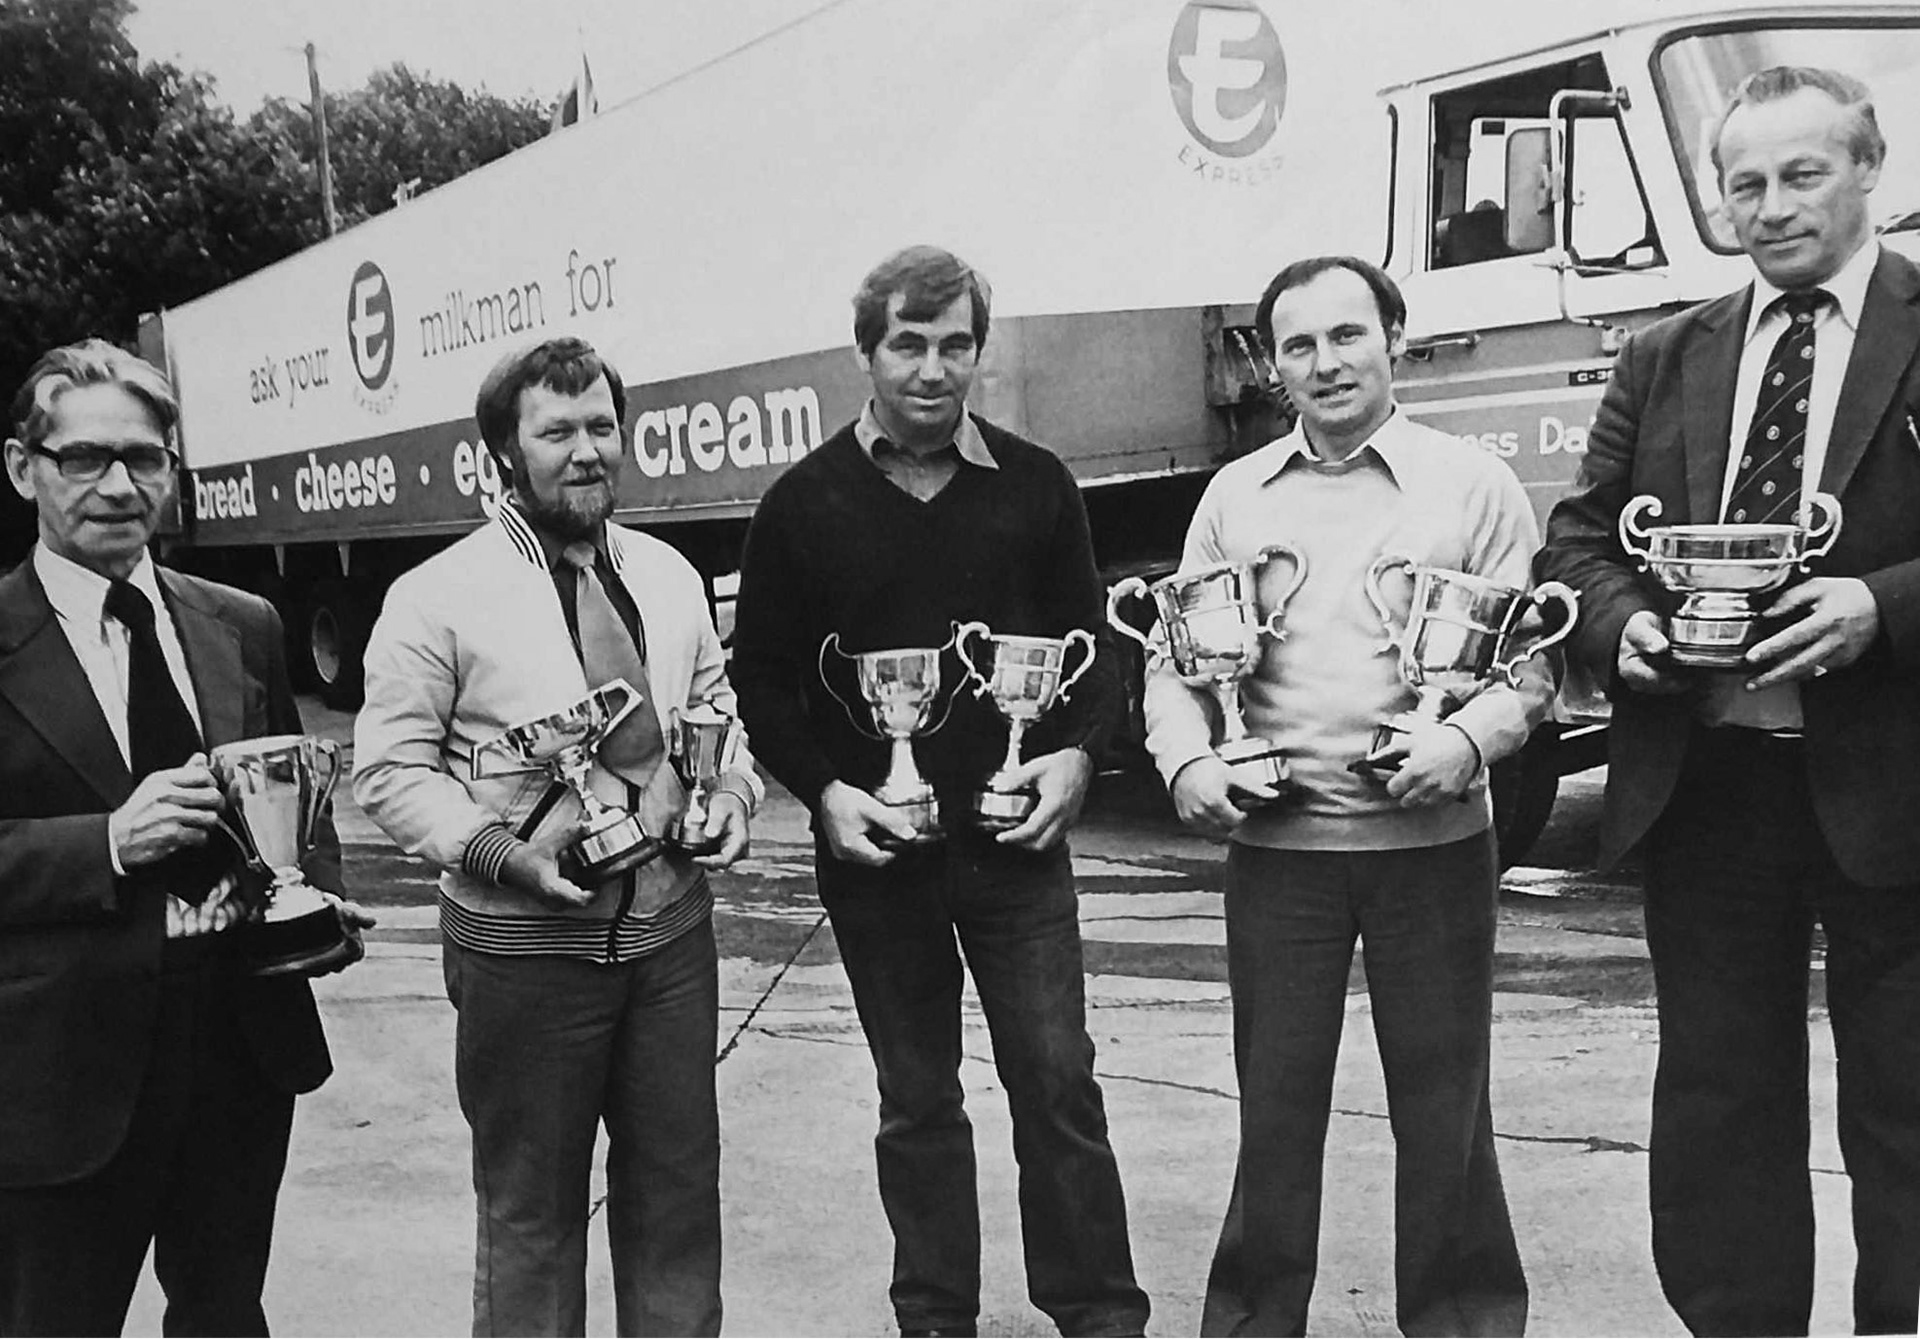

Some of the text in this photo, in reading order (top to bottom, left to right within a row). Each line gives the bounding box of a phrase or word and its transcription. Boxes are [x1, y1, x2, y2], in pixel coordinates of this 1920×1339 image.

[249, 354, 281, 404] ask
[285, 347, 329, 409] your
[419, 280, 546, 358] milkman
[565, 248, 617, 318] for
[192, 385, 823, 520] bread cheese eg cream
[1538, 413, 1598, 457] Da
